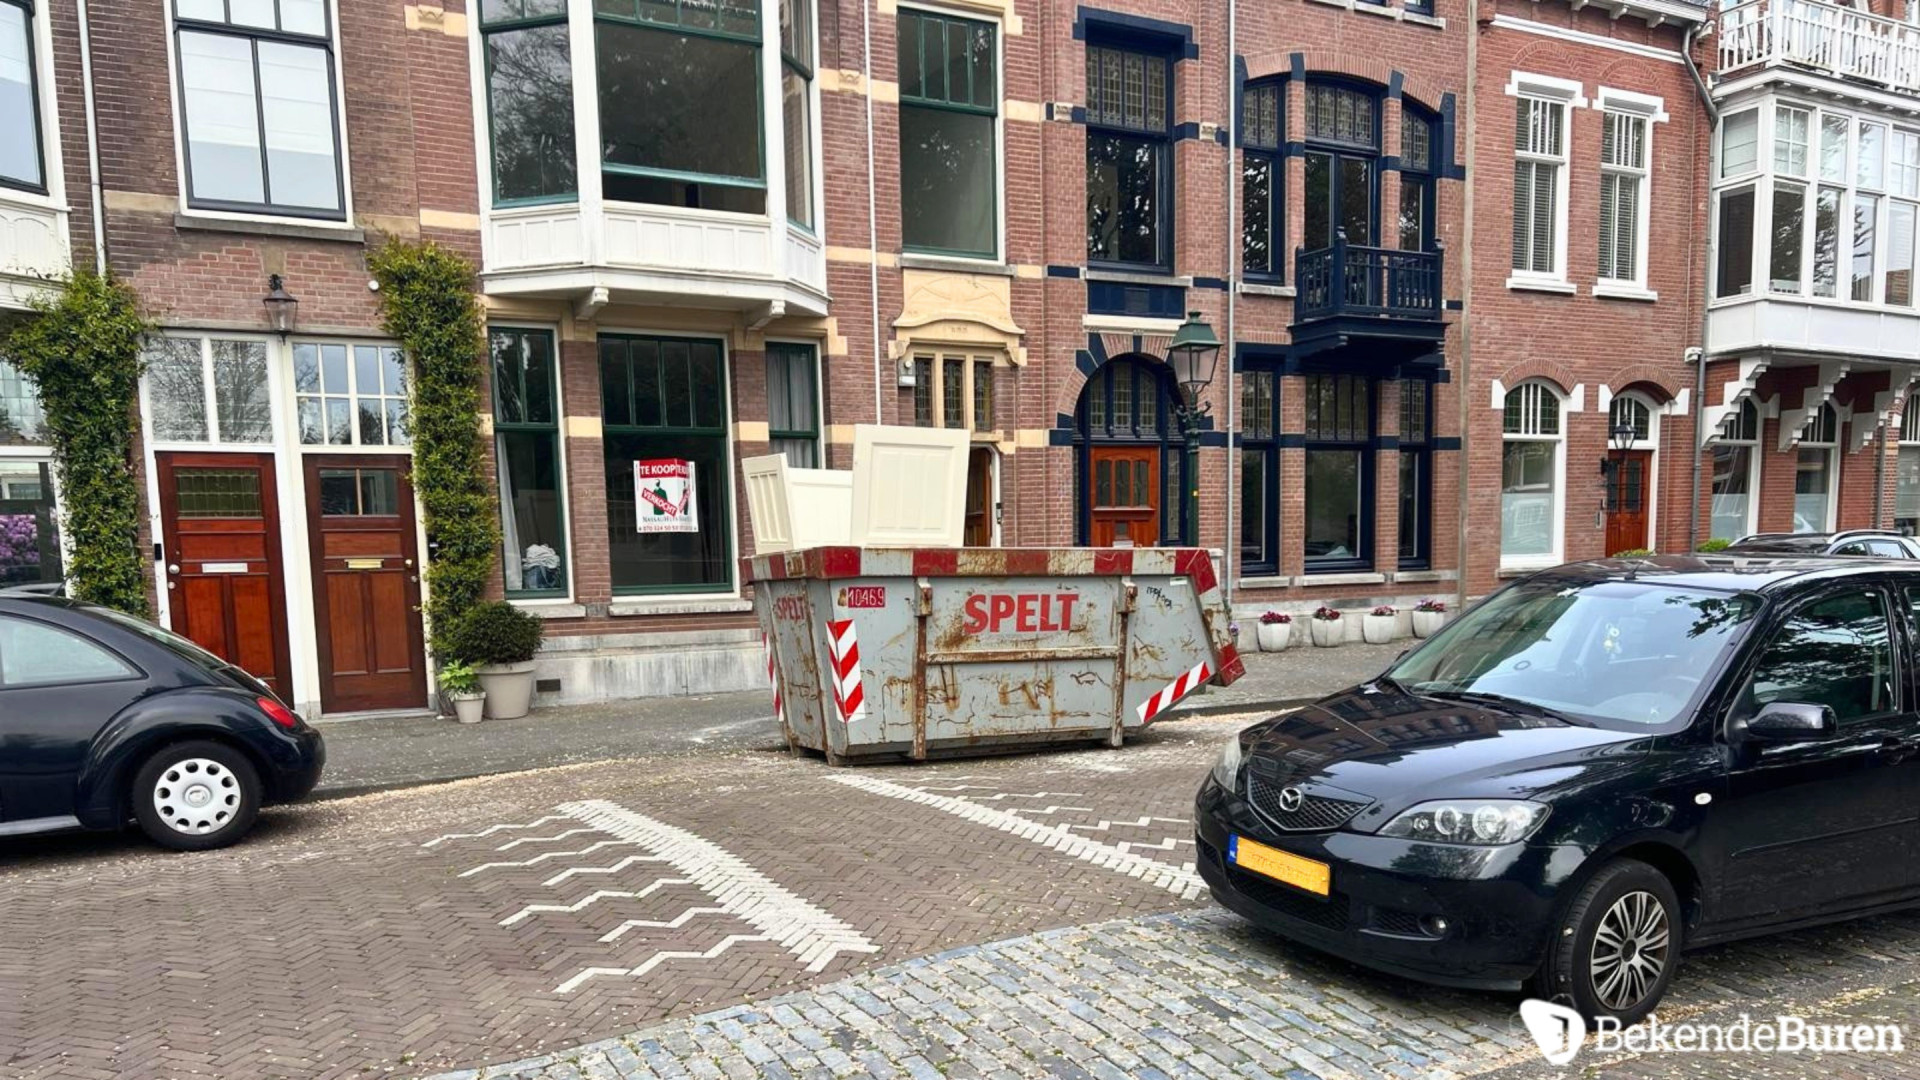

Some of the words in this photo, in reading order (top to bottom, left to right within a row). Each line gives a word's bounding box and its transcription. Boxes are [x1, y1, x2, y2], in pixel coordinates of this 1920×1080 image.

[640, 465, 650, 475] TE
[651, 464, 676, 474] KOOP
[643, 489, 677, 515] VERKOCHT
[776, 595, 805, 621] SPELT
[848, 588, 884, 606] 10469
[964, 594, 1079, 634] SPELT
